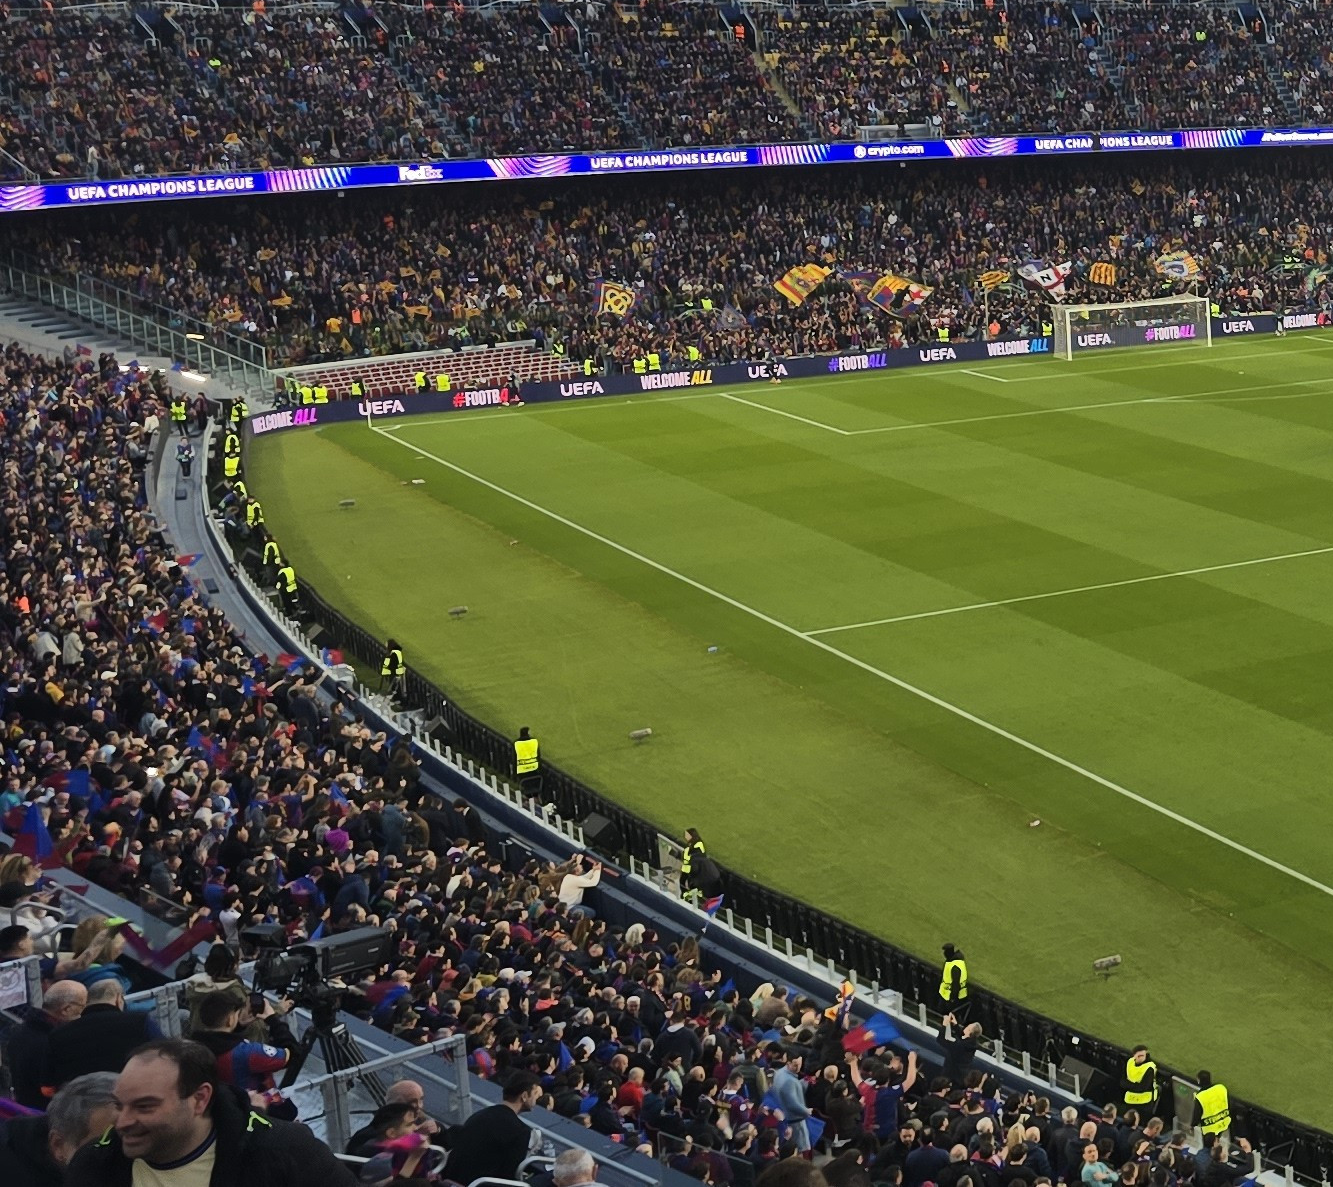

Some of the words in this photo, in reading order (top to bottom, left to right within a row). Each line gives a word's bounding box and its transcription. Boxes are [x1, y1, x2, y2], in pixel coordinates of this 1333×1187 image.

[867, 144, 925, 158] crypto.com
[1035, 138, 1064, 150] UEFA
[1131, 135, 1173, 147] LEAGUE
[590, 156, 623, 169] UEFA
[625, 152, 699, 167] CHAMPIONS
[701, 150, 748, 163] LEAGUE
[399, 165, 444, 181] FedEx
[68, 186, 107, 201] UEFA
[108, 180, 196, 198] CHAMPIONS
[198, 176, 254, 192] LEAGUE
[1144, 323, 1196, 342] #FOOTBALL
[1222, 319, 1255, 334] UEFA
[987, 339, 1030, 356] WELCOME
[1030, 338, 1049, 352] ALL
[1078, 333, 1112, 347] UEFA
[828, 352, 888, 372] #FOOTBALL
[920, 347, 957, 362] UEFA
[640, 371, 691, 390] WELCOME
[691, 369, 713, 385] ALL
[560, 380, 605, 397] UEFA
[358, 399, 405, 416] UEFA
